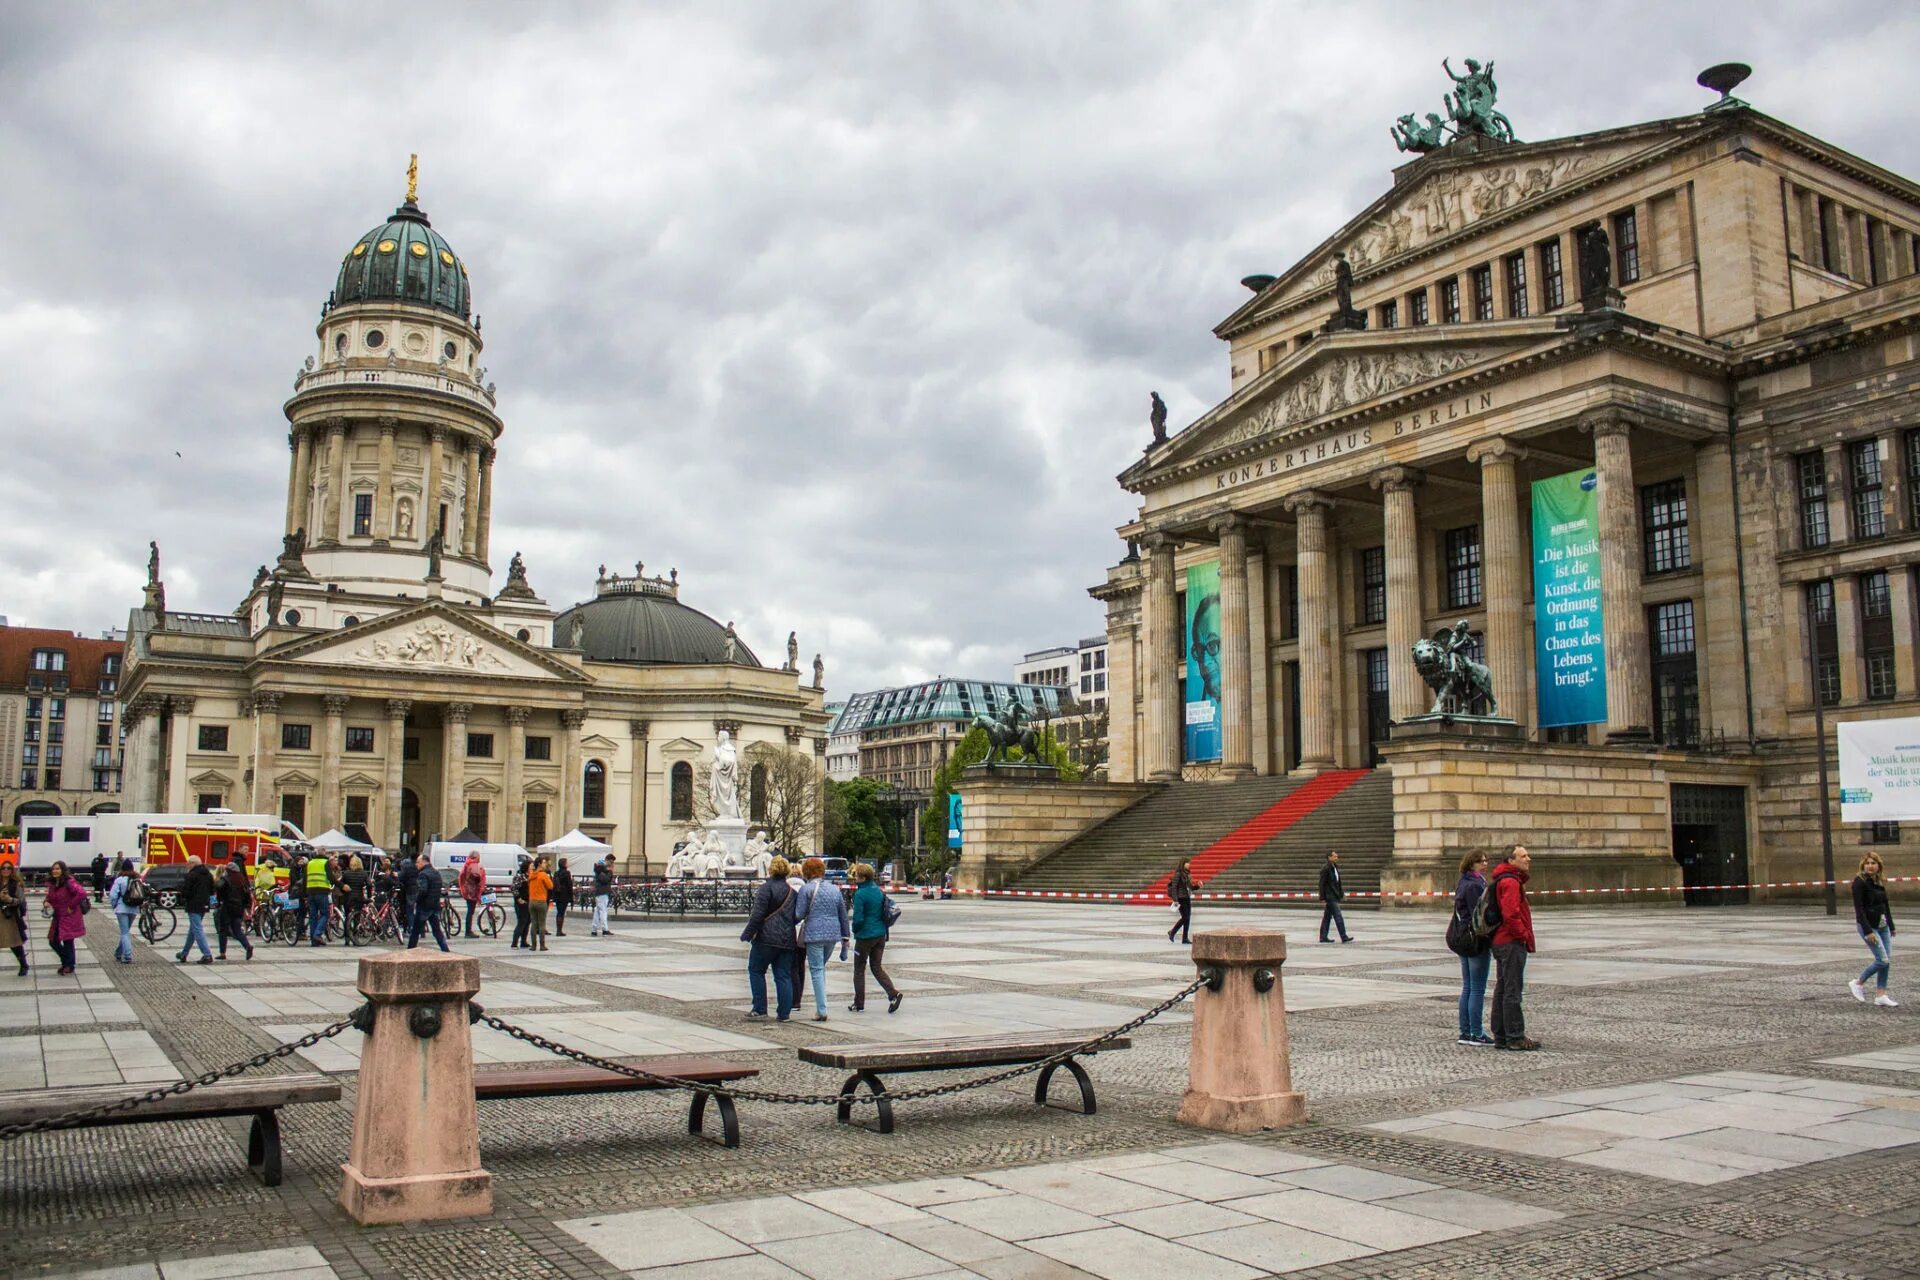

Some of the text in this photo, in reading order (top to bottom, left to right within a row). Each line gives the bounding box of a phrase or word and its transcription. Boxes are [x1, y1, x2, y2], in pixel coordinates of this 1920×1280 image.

[1216, 391, 1492, 489] KONZERTHAUS BERLIN
[1538, 538, 1599, 564] „Die Musik
[1555, 559, 1589, 578] ist die
[1544, 575, 1600, 598] Kunst, die
[1546, 596, 1598, 615] Ordnung
[1555, 614, 1589, 632] in das
[1545, 630, 1601, 651] Chaos des
[1553, 651, 1593, 668] Lebens
[1867, 767, 1881, 777] der
[1885, 766, 1908, 777] Stille
[1884, 780, 1894, 788] in
[1896, 779, 1911, 788] die
